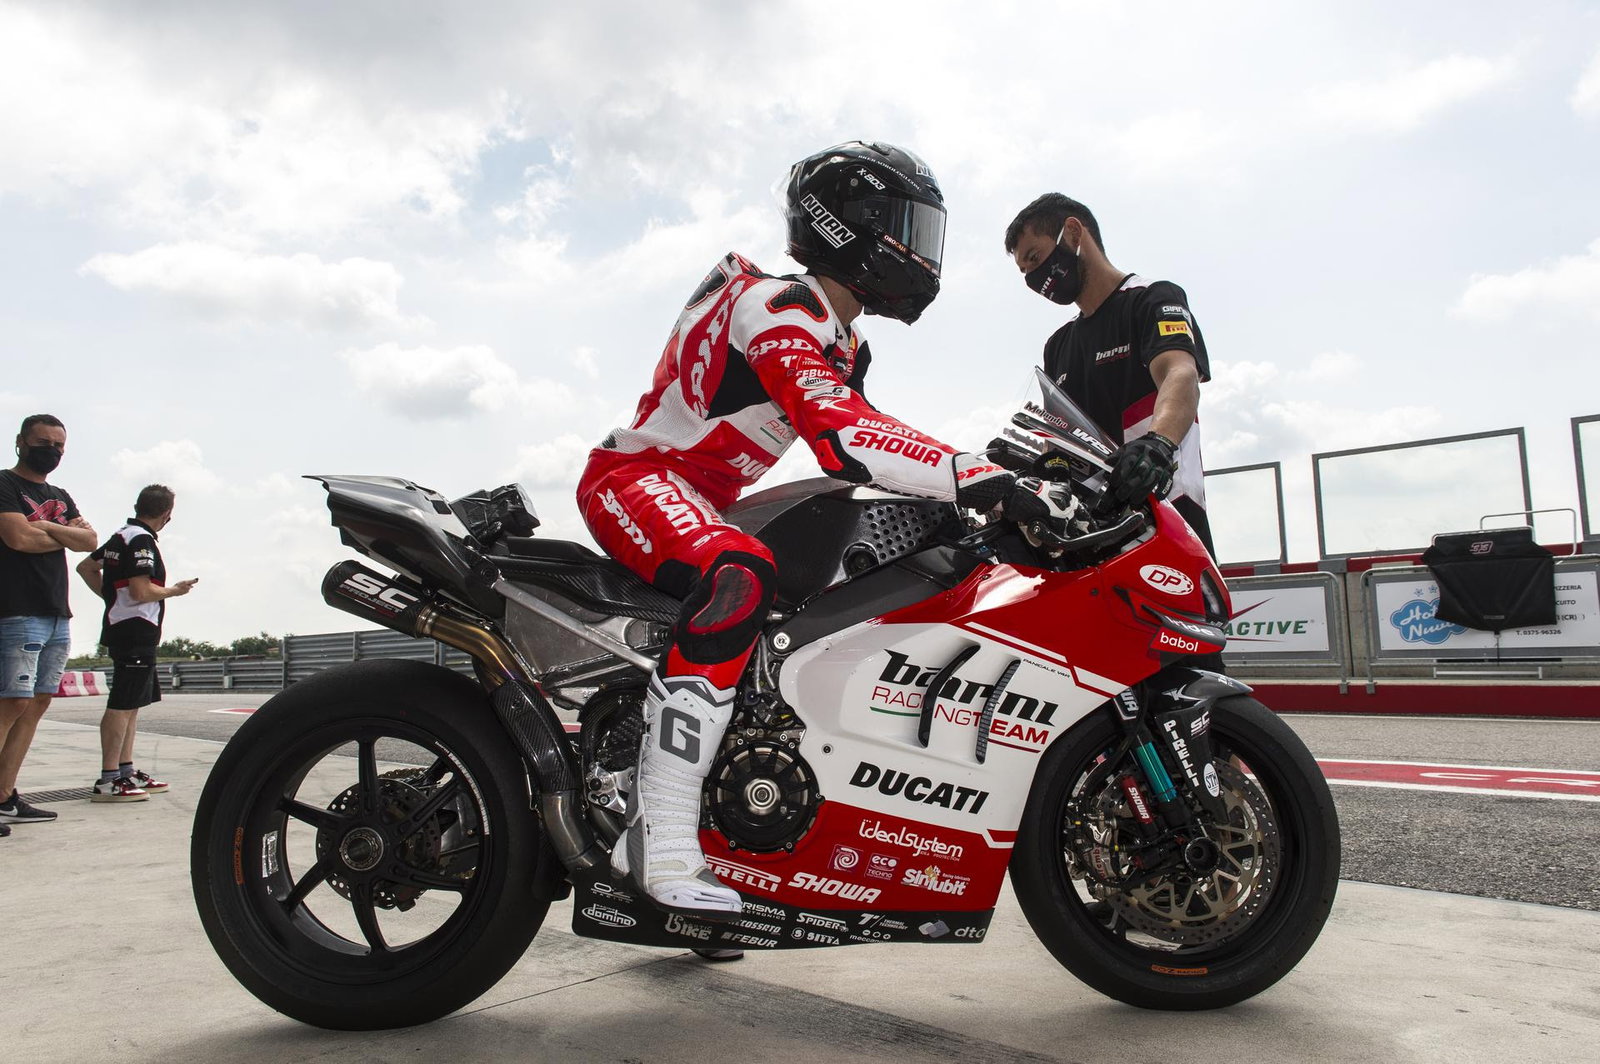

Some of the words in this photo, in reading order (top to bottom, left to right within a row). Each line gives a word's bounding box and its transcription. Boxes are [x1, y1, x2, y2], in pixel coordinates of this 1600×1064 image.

[801, 193, 856, 249] NOLAN
[856, 417, 918, 440] DUCATI
[849, 430, 943, 468] SHOWA
[596, 488, 653, 554] SPIDI
[635, 473, 702, 536] DUCATI
[343, 572, 419, 609] SC
[1160, 632, 1199, 652] babol
[659, 706, 701, 764] G
[1163, 719, 1200, 788] PIRELLI
[849, 761, 990, 814] DUCATI
[1128, 787, 1150, 819] SHOWA
[787, 871, 882, 904] SHOWA
[587, 903, 631, 926] domino
[796, 912, 845, 931] SPIDER
[732, 931, 778, 948] FEBUR
